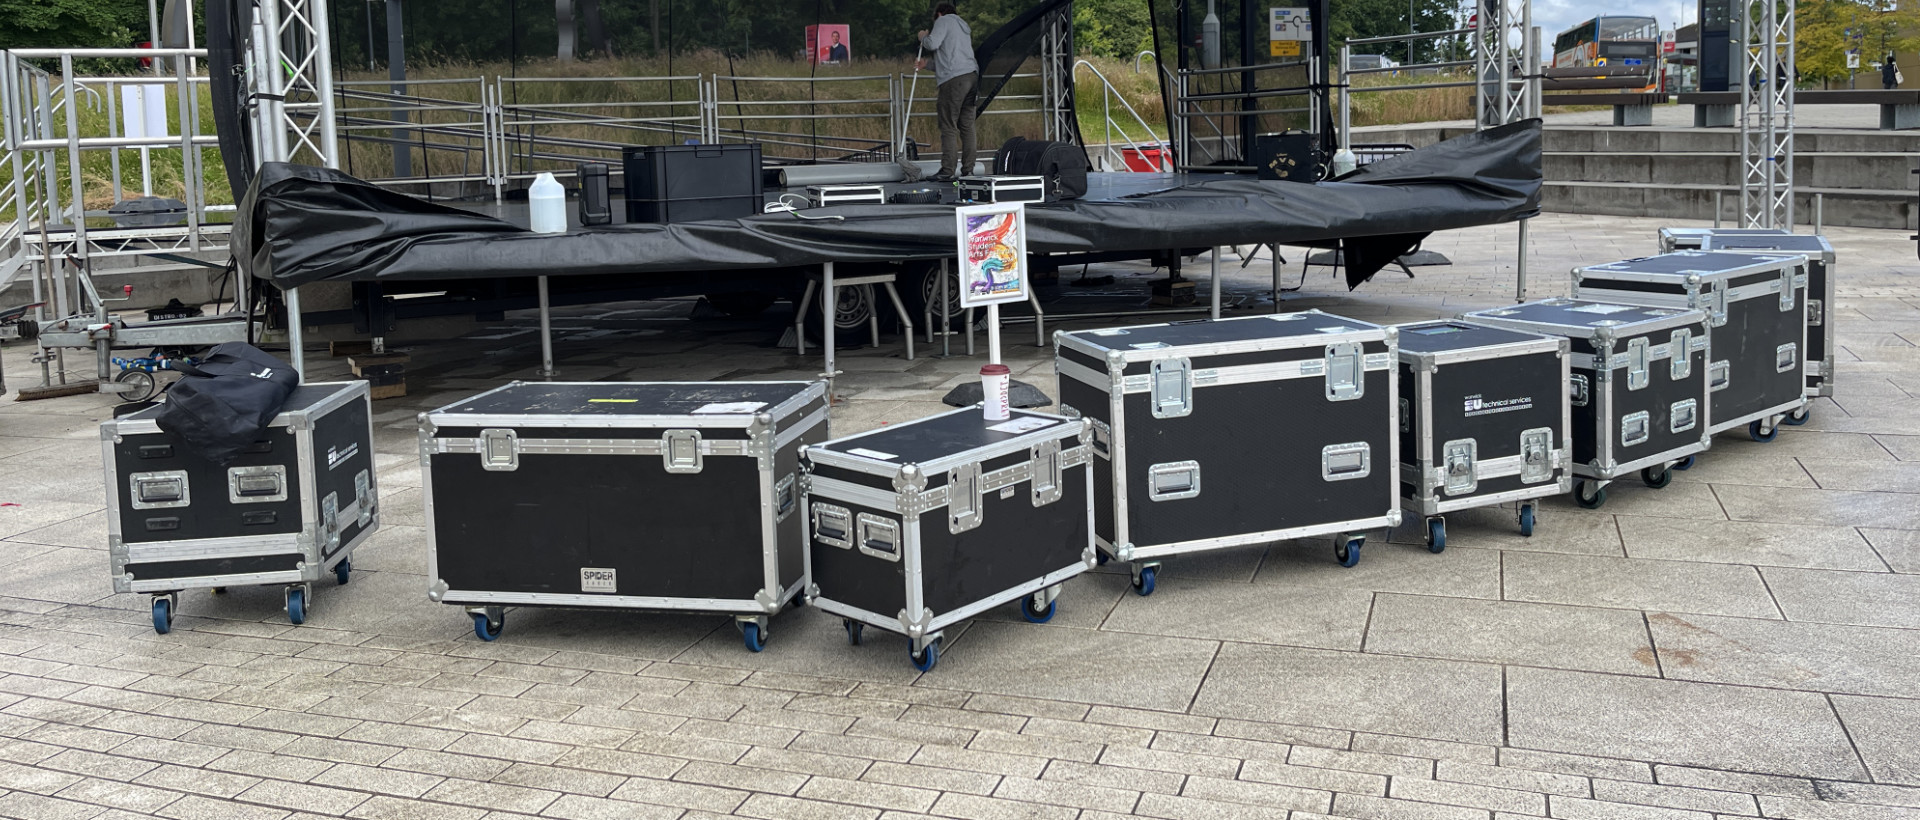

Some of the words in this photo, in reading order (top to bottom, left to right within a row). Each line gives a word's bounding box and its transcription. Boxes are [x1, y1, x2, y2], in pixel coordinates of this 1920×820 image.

[968, 235, 999, 243] Warwick
[968, 242, 996, 251] Student
[968, 250, 984, 258] Arts
[1483, 400, 1508, 409] technical
[1509, 397, 1532, 405] services
[583, 571, 614, 581] SPIDER
